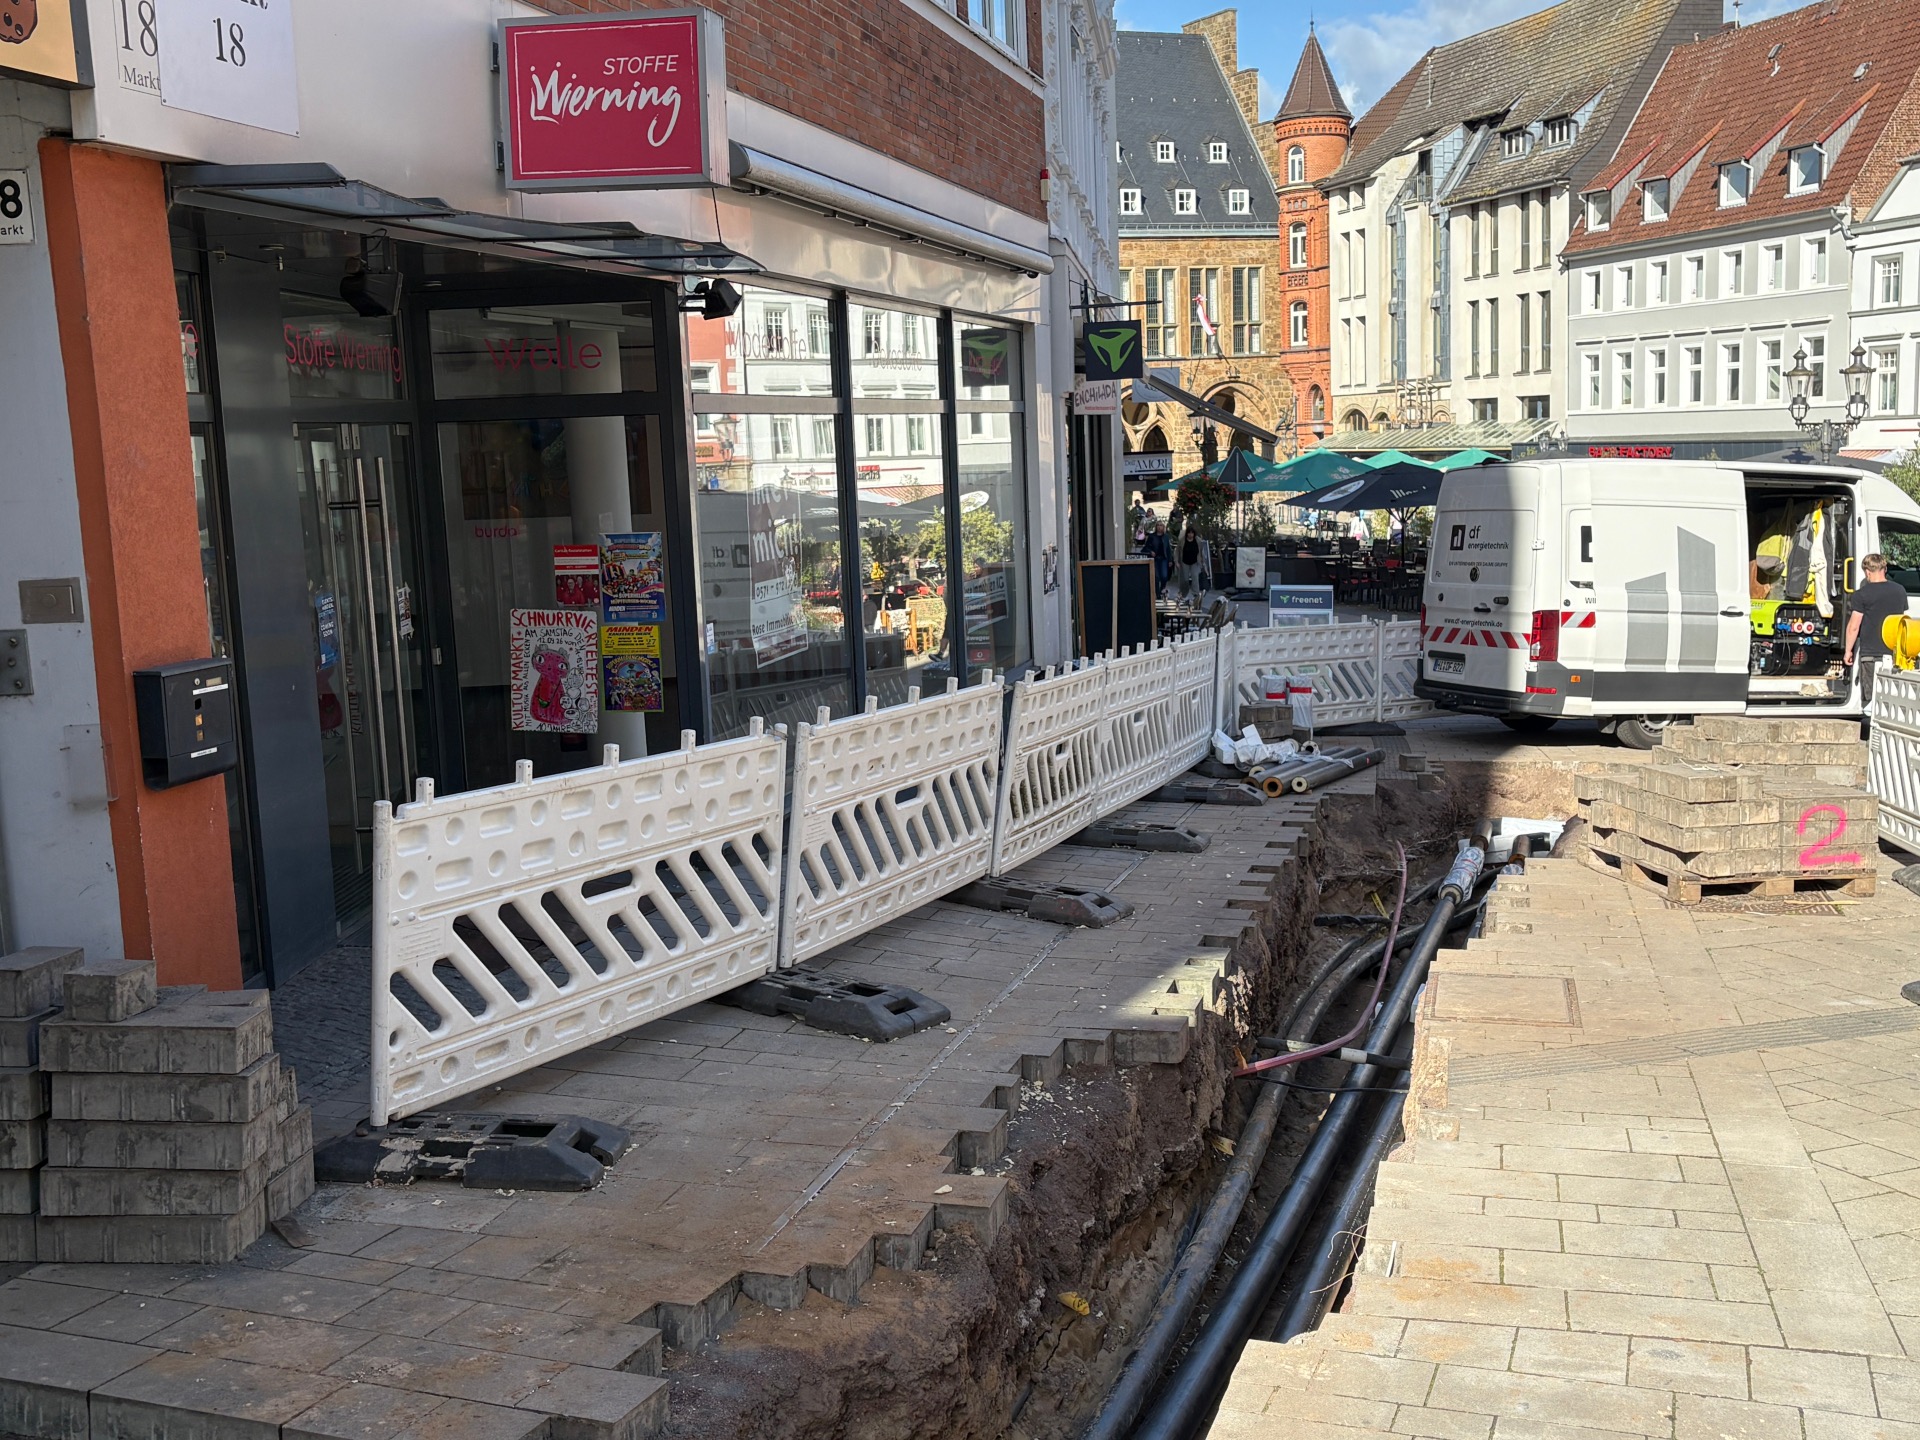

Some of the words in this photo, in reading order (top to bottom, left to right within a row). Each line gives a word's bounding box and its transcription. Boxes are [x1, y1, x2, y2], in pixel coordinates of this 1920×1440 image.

[121, 0, 158, 57] 18
[212, 17, 247, 67] 18
[603, 54, 679, 76] STOFFE
[284, 324, 336, 369] Stoffe
[725, 320, 807, 360] Modestoffe
[484, 336, 603, 372] Wolle
[474, 525, 518, 538] burda
[1469, 525, 1482, 539] df
[1467, 542, 1509, 551] energietechnik
[1291, 595, 1323, 604] freenet
[752, 620, 766, 635] Rose
[1444, 617, 1503, 628] www.df-energietechnik.de
[540, 628, 573, 638] SAMSTAG
[1796, 804, 1862, 867] 2
